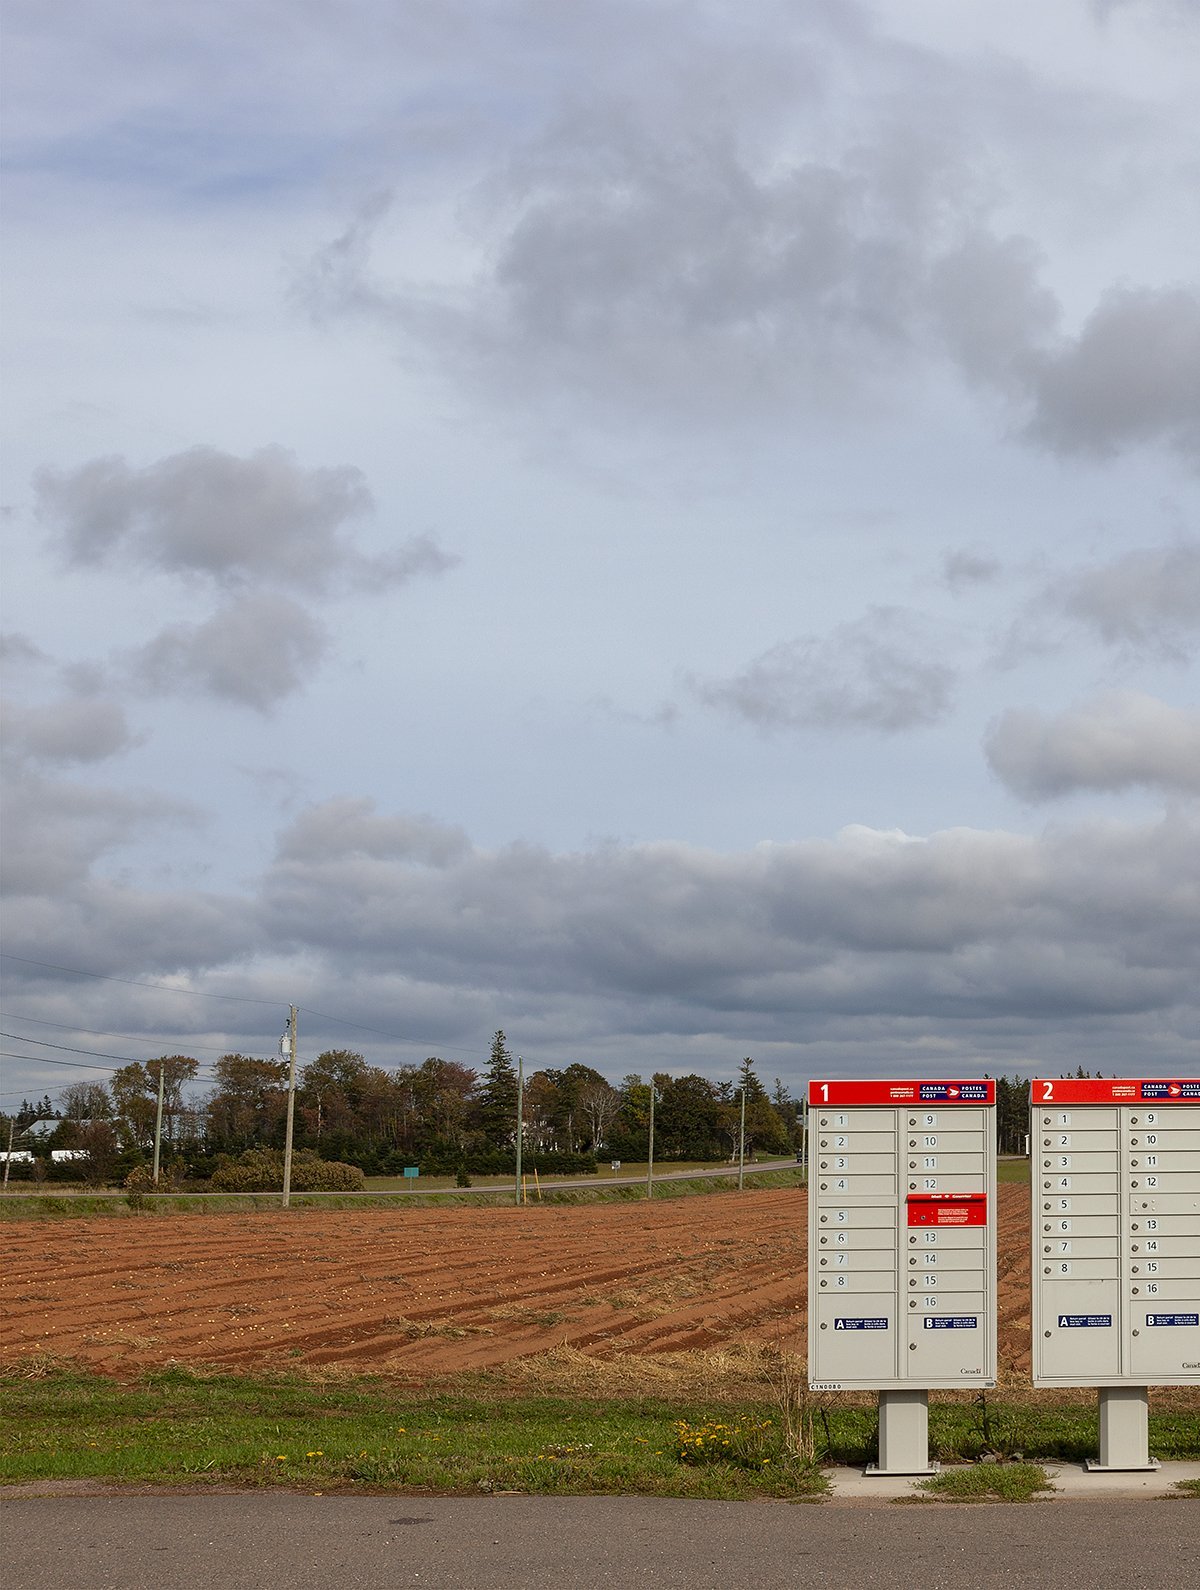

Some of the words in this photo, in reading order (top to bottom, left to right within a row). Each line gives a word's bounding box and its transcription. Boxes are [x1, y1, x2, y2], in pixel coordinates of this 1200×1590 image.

[820, 1084, 828, 1101] 1
[1042, 1082, 1054, 1100] 2
[927, 1115, 933, 1125] 9
[1148, 1114, 1154, 1123] 9
[838, 1137, 844, 1146] 2
[925, 1136, 936, 1146] 10
[1061, 1135, 1067, 1145] 2
[1147, 1135, 1156, 1144] 10
[838, 1158, 844, 1168] 3
[925, 1158, 935, 1167] 11
[1062, 1157, 1068, 1166] 3
[1148, 1156, 1156, 1165] 11
[838, 1180, 844, 1188] 4
[925, 1179, 936, 1189] 12
[1061, 1178, 1067, 1187] 4
[1147, 1177, 1156, 1186] 12
[1061, 1199, 1067, 1209] 5
[838, 1212, 845, 1221] 5
[1061, 1220, 1068, 1230] 6
[1147, 1220, 1157, 1229] 13
[838, 1233, 845, 1242] 6
[925, 1233, 936, 1242] 13
[1062, 1242, 1068, 1251] 7
[1147, 1241, 1157, 1250] 14
[838, 1255, 844, 1264] 7
[925, 1254, 936, 1263] 14
[1061, 1263, 1068, 1273] 8
[1147, 1262, 1157, 1272] 15
[838, 1276, 845, 1286] 8
[925, 1275, 936, 1285] 15
[1147, 1283, 1158, 1293] 16
[925, 1297, 936, 1306] 16
[836, 1320, 844, 1329] A
[926, 1319, 933, 1328] B
[1060, 1317, 1068, 1326] A
[1148, 1316, 1154, 1325] B
